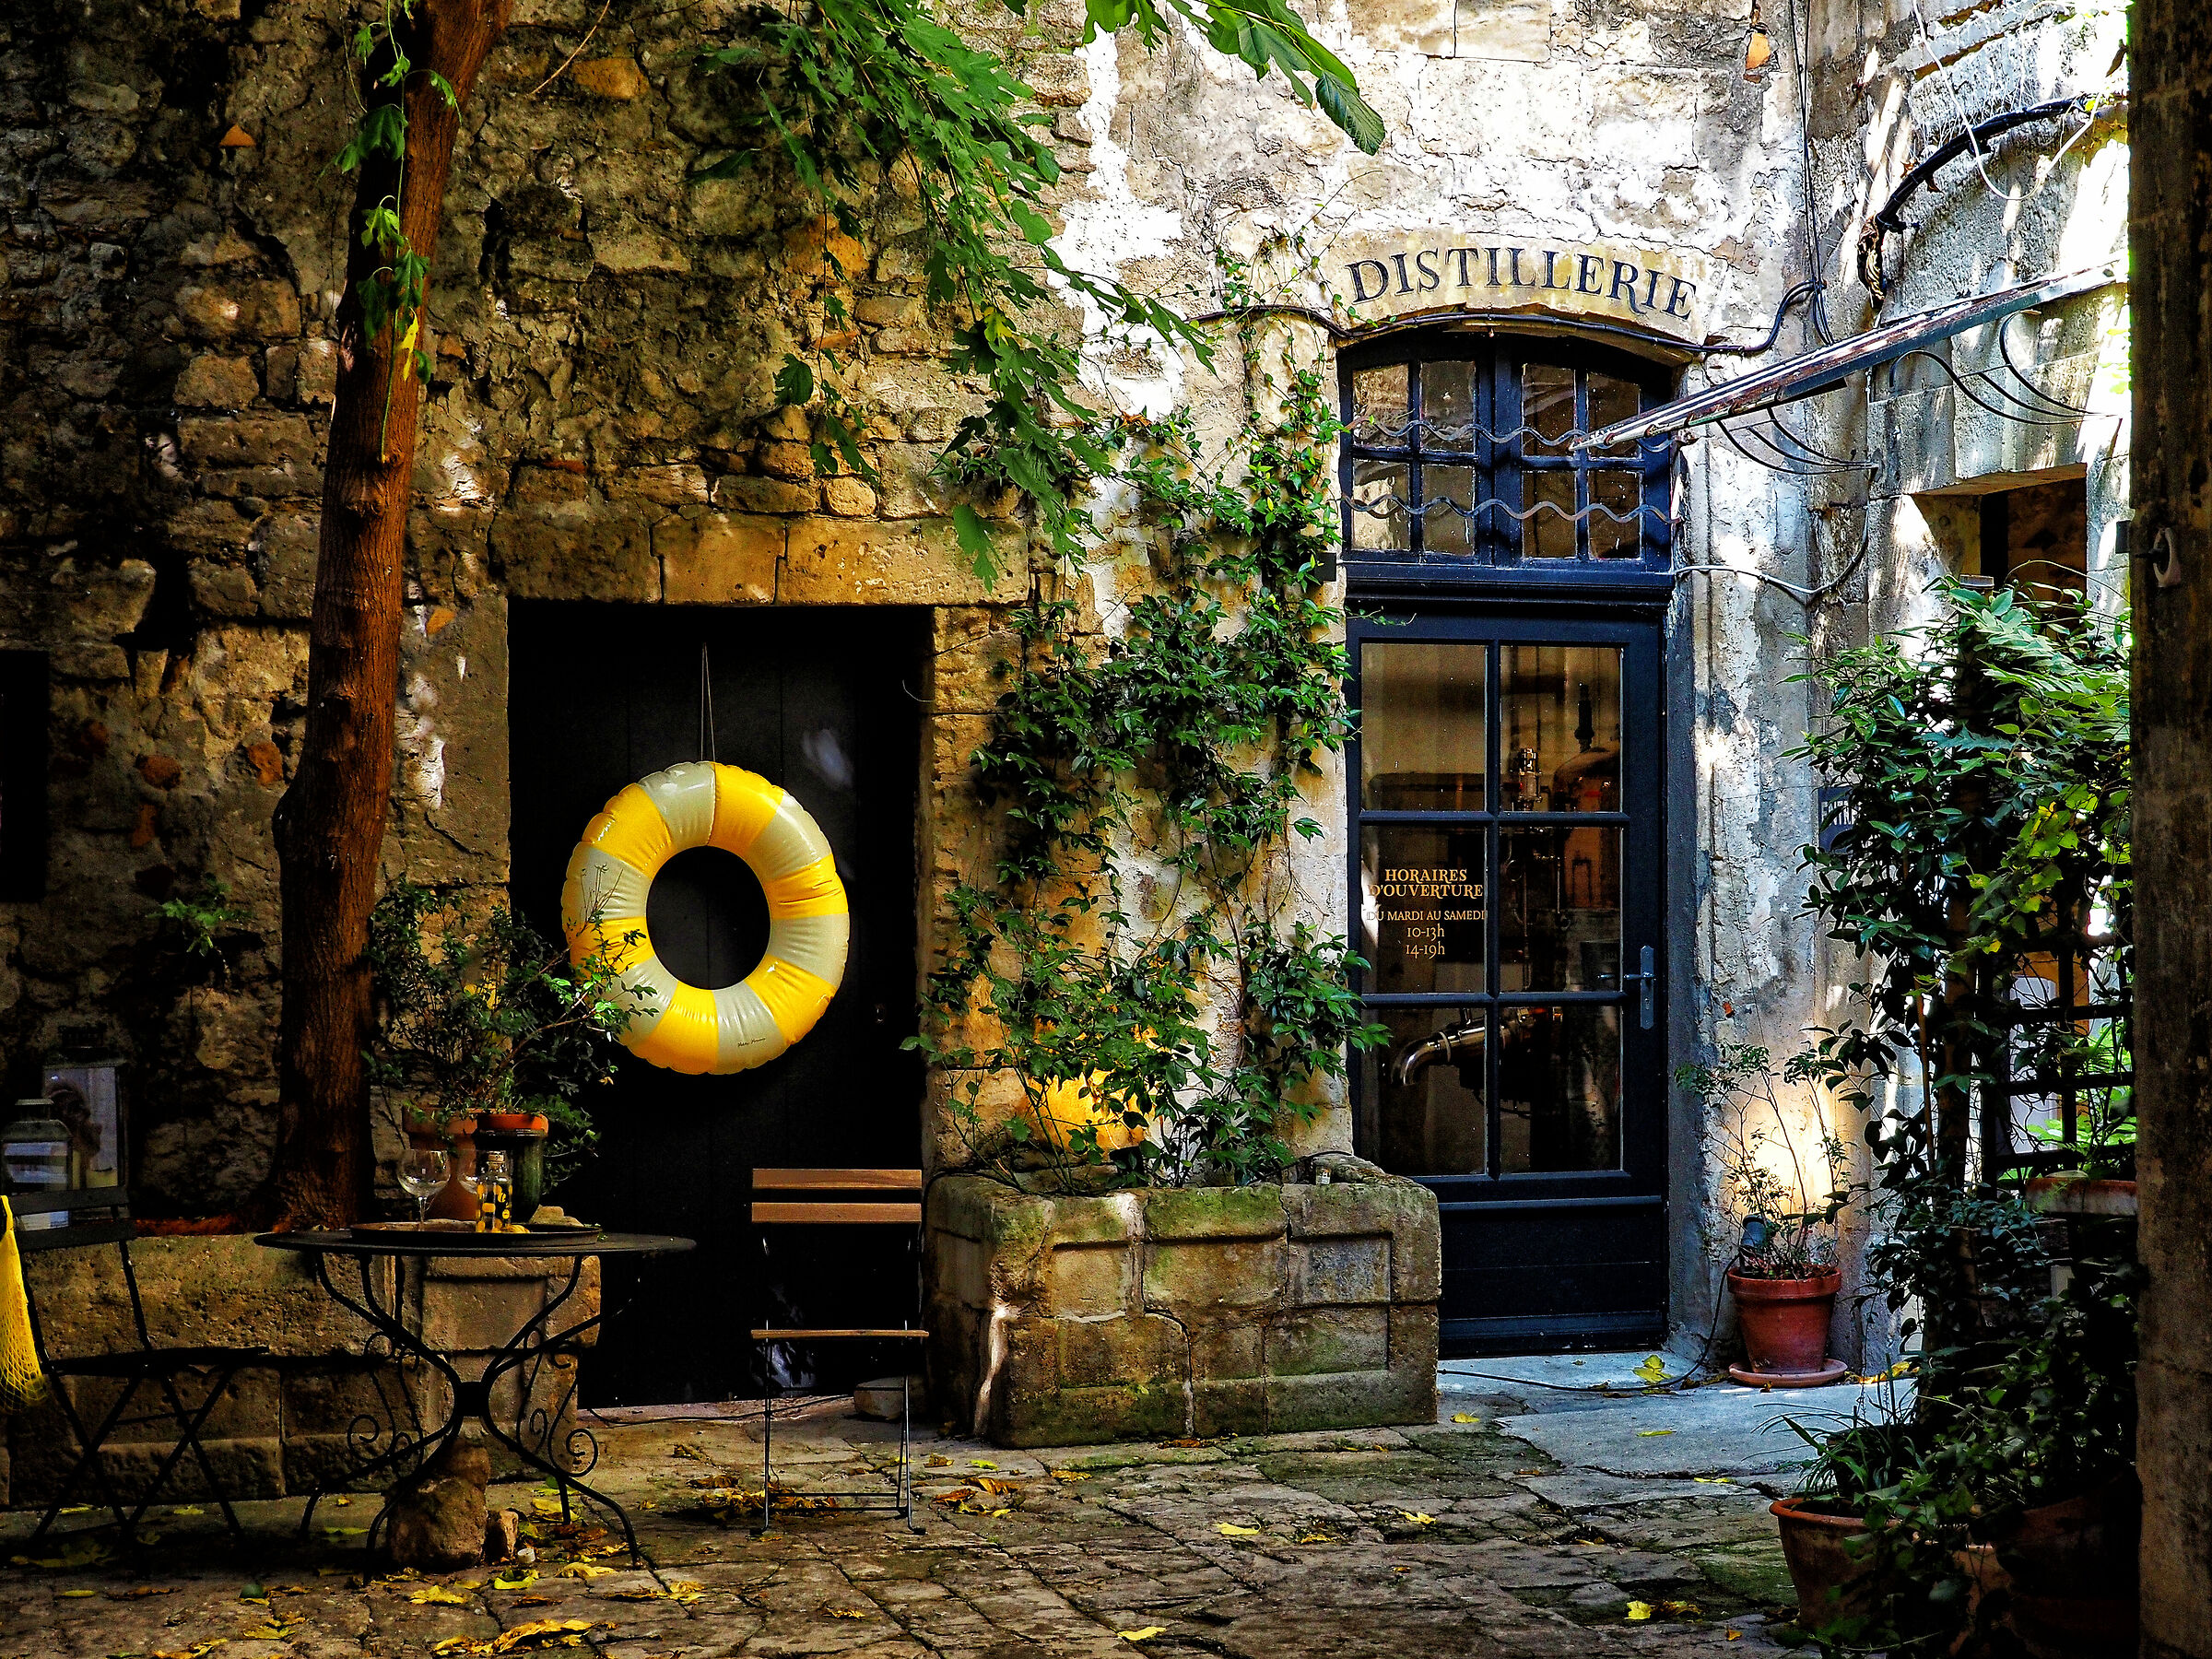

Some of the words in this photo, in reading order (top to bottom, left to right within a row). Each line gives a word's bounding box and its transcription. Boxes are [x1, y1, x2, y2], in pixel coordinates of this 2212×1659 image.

[1345, 247, 1697, 321] DISTILLERIE
[1384, 868, 1467, 884] HORAIRES
[1368, 884, 1483, 899] D'OUVERTURE
[1387, 911, 1424, 921] MARDI
[1426, 911, 1441, 921] AU
[1443, 910, 1488, 921] SAMEDI
[1406, 923, 1445, 942] 10-13h
[1406, 940, 1445, 959] 14-19h
